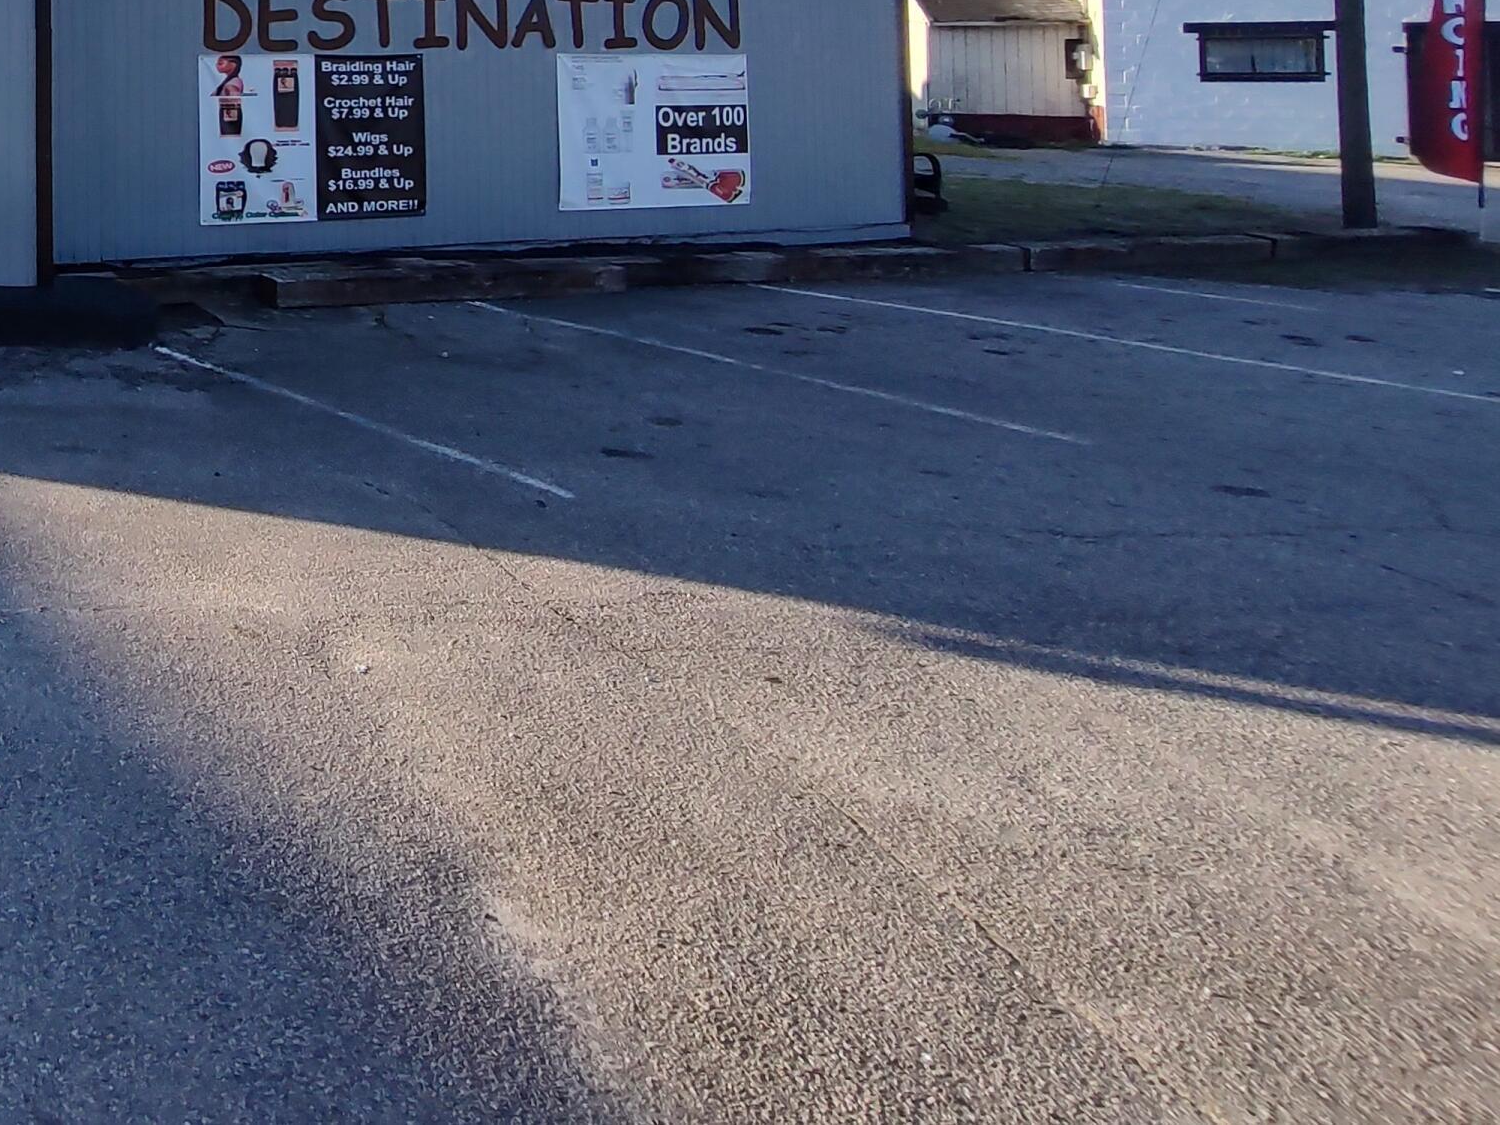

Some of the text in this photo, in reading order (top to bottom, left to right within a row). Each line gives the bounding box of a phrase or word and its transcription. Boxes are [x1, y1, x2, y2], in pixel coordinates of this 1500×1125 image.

[321, 61, 416, 73] Braiding Hair
[331, 74, 408, 86] $2.99 & Up
[323, 96, 414, 108] Crochet Hair
[331, 108, 409, 120] $7.99 & Up
[658, 106, 745, 126] Over 100
[352, 132, 389, 145] Wigs
[667, 133, 737, 153] Brands
[327, 144, 413, 157] $24.99 & Up
[341, 168, 400, 179] Bundles
[328, 178, 414, 191] $16.99 & Up
[326, 200, 418, 213] AND MORE!!
